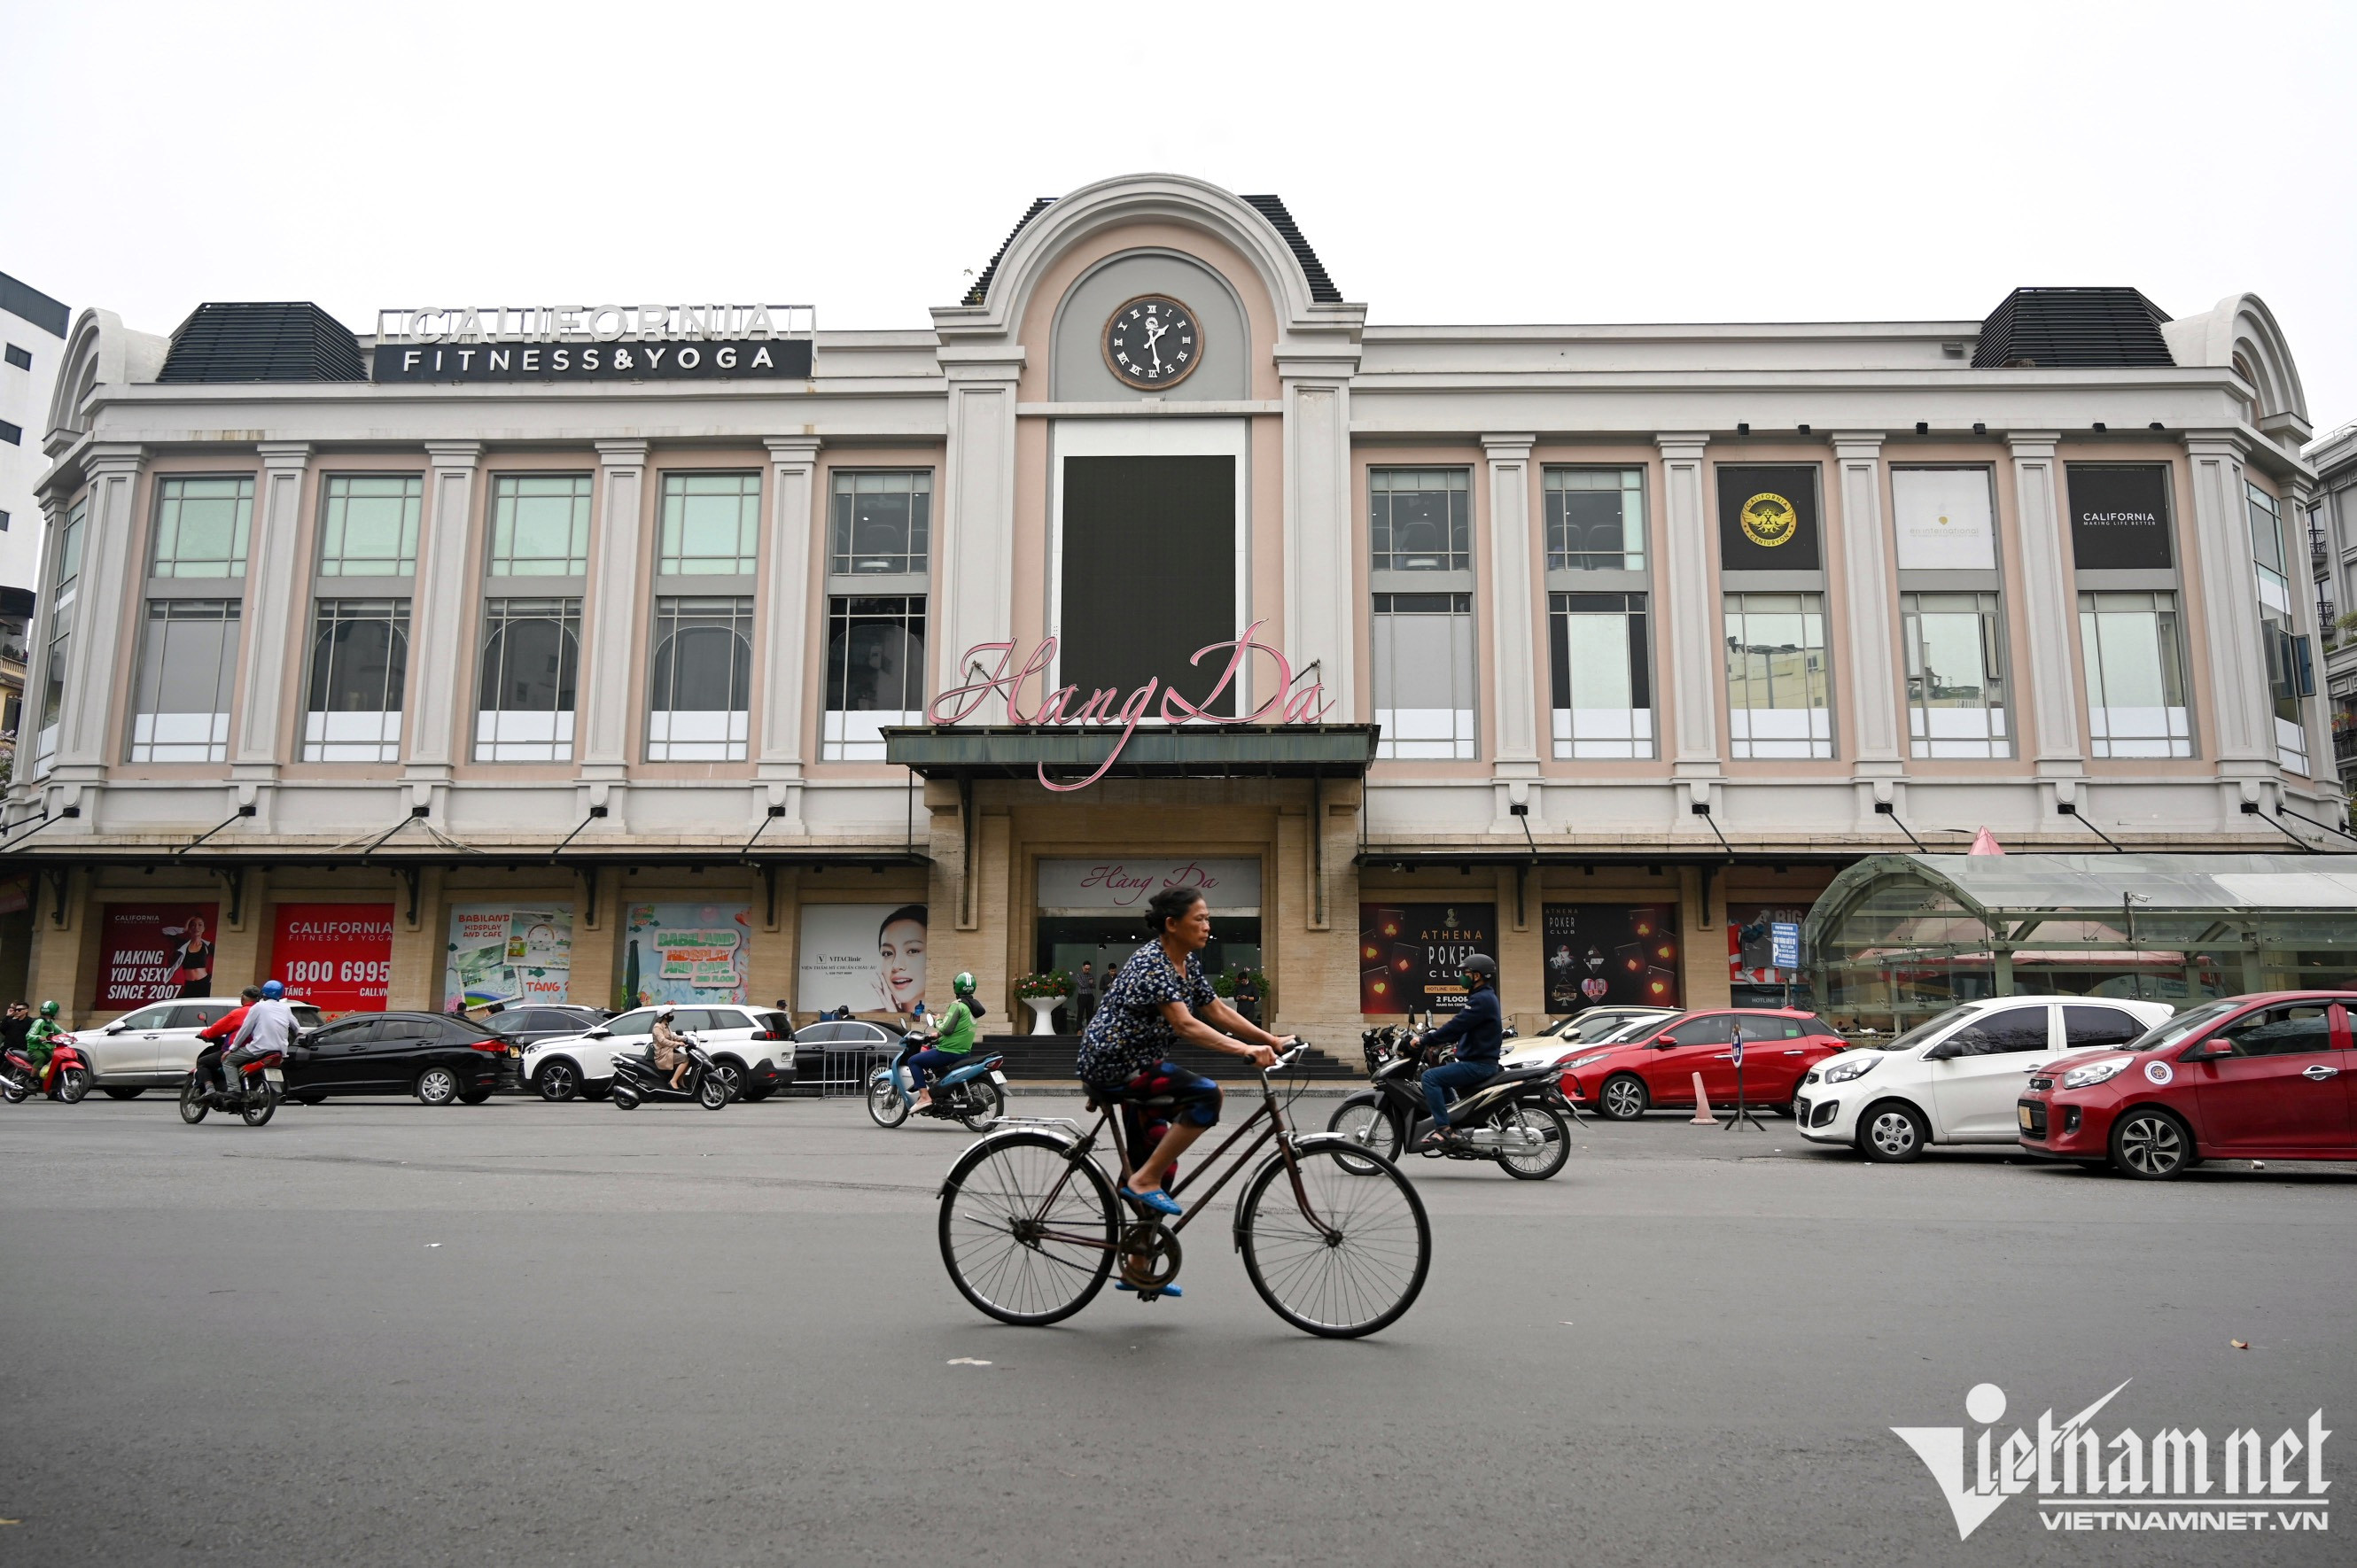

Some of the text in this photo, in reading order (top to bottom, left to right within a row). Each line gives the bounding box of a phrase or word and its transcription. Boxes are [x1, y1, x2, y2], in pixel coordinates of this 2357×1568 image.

[408, 302, 780, 344] CALIFORNIA
[1746, 494, 1788, 508] CALIFORNIA
[1763, 514, 1773, 525] X
[2083, 512, 2155, 521] CALIFORNIA
[1080, 865, 1154, 906] Hàng
[289, 922, 393, 934] CALIFORNIA
[1549, 917, 1575, 927] POKER
[658, 933, 737, 947] BABILAND
[1421, 930, 1482, 939] ATHENA
[113, 950, 164, 964] MAKING
[667, 950, 730, 962] KIDSPLAY
[1773, 943, 1778, 963] P
[111, 968, 171, 982] YOU SEXY
[286, 961, 390, 982] 1800 6995
[664, 962, 730, 974] AND CAFE
[108, 985, 182, 999] SINCE 2007
[306, 987, 311, 996] 4
